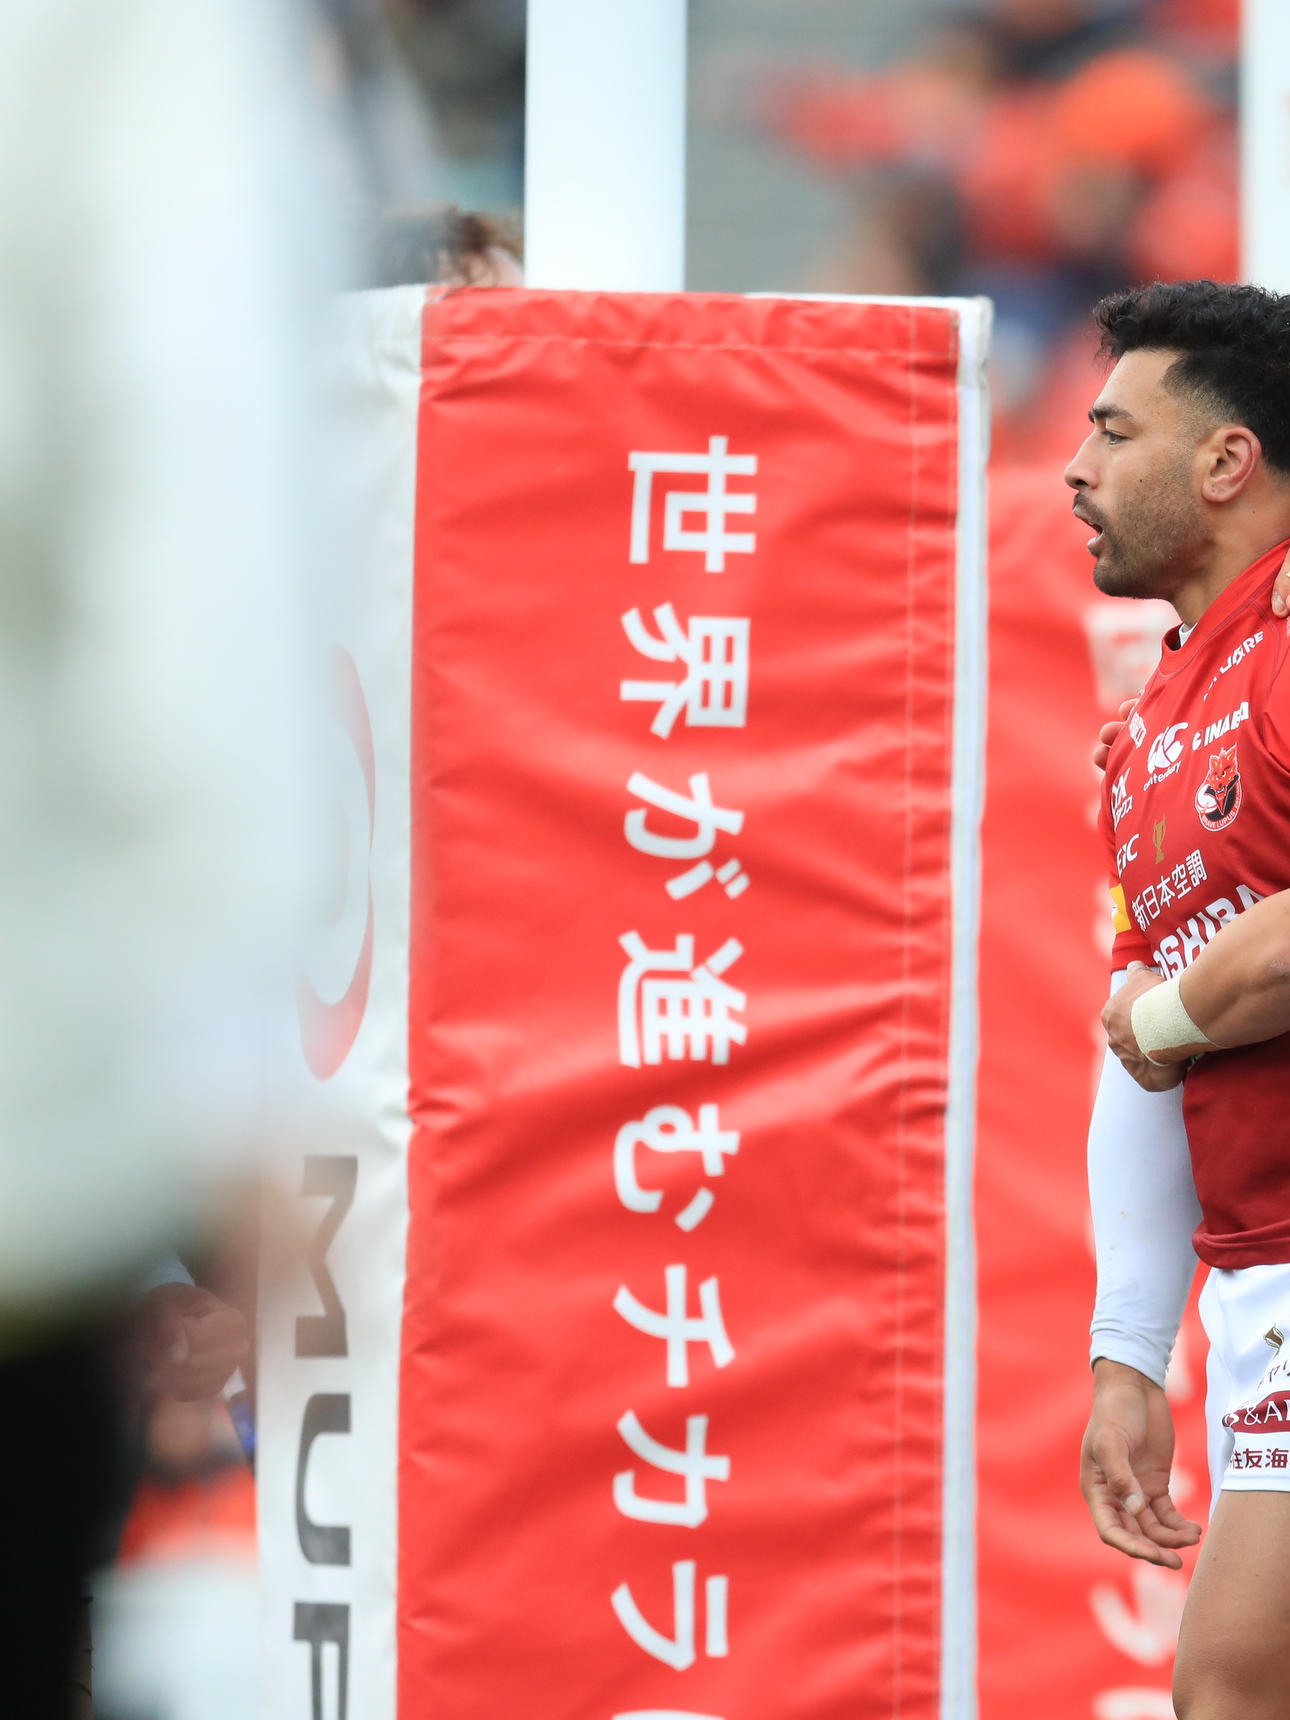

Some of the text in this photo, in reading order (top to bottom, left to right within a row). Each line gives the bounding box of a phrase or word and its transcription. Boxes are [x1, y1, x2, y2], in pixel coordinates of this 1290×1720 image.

[1131, 849, 1208, 931] 新日本空調
[1152, 884, 1264, 981] OSHIBA
[611, 435, 758, 1720] 世界が進むチカラ
